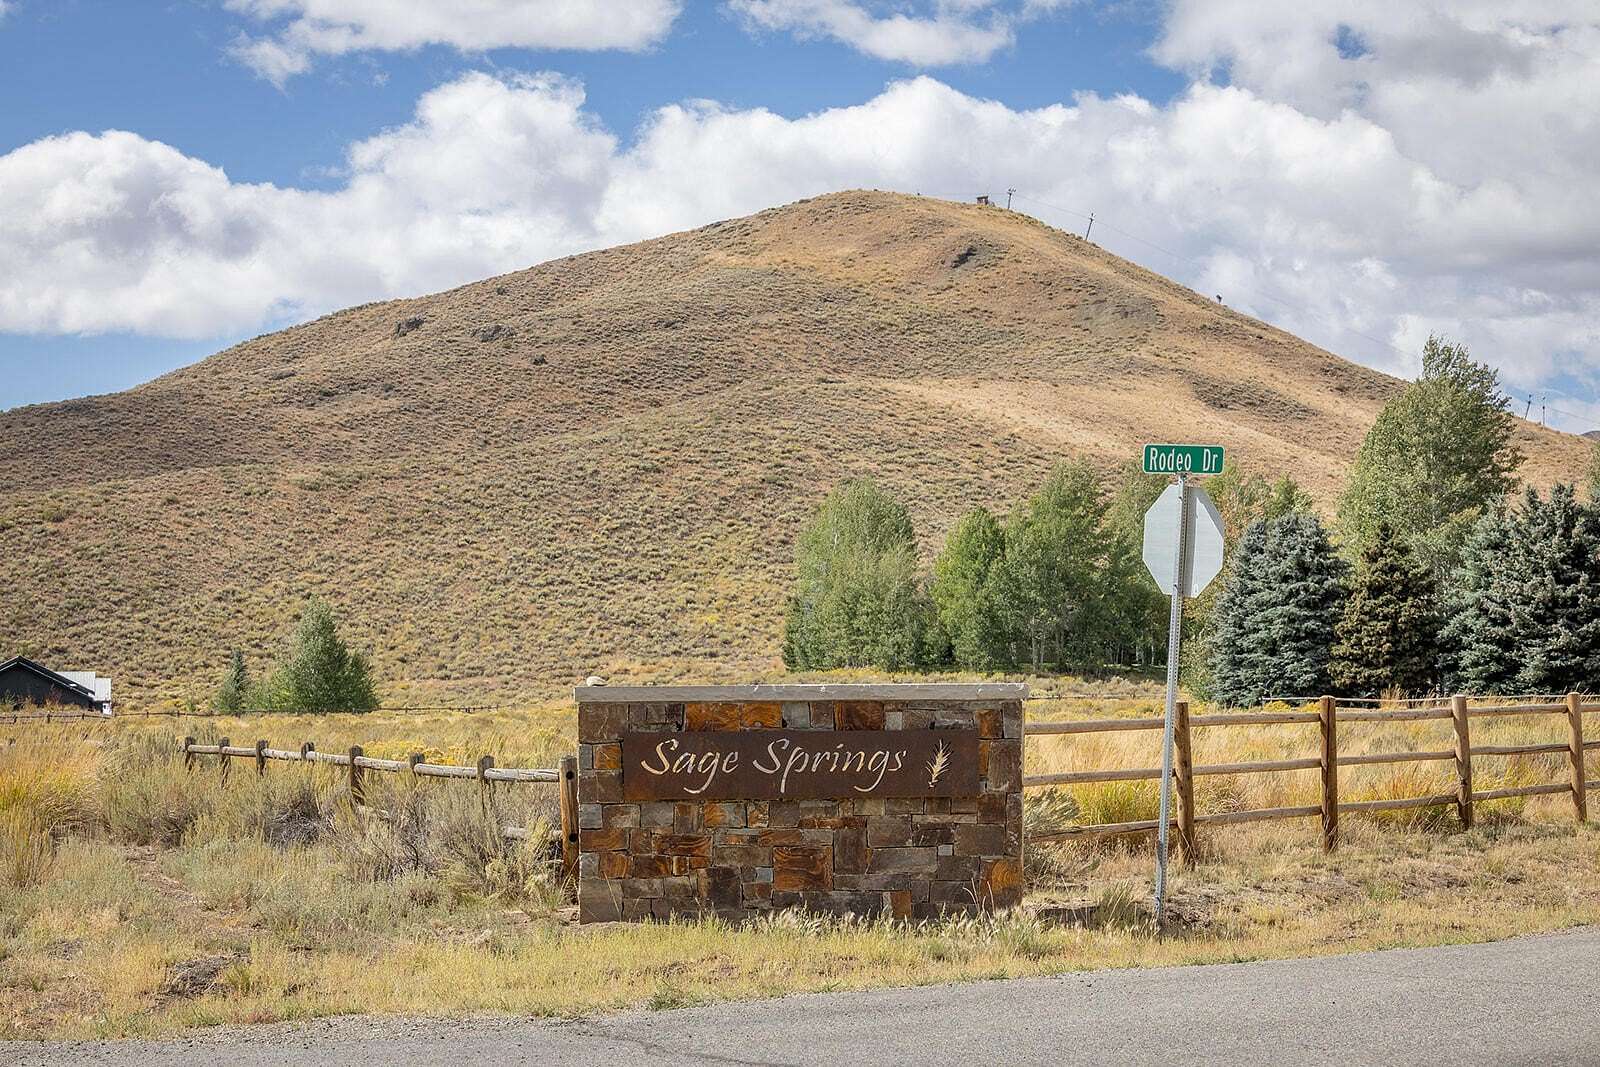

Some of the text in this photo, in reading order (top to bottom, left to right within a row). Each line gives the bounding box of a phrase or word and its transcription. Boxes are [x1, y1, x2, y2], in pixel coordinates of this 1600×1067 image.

[1149, 447, 1219, 472] Rodeo Dr
[640, 737, 907, 794] Sage Springs
